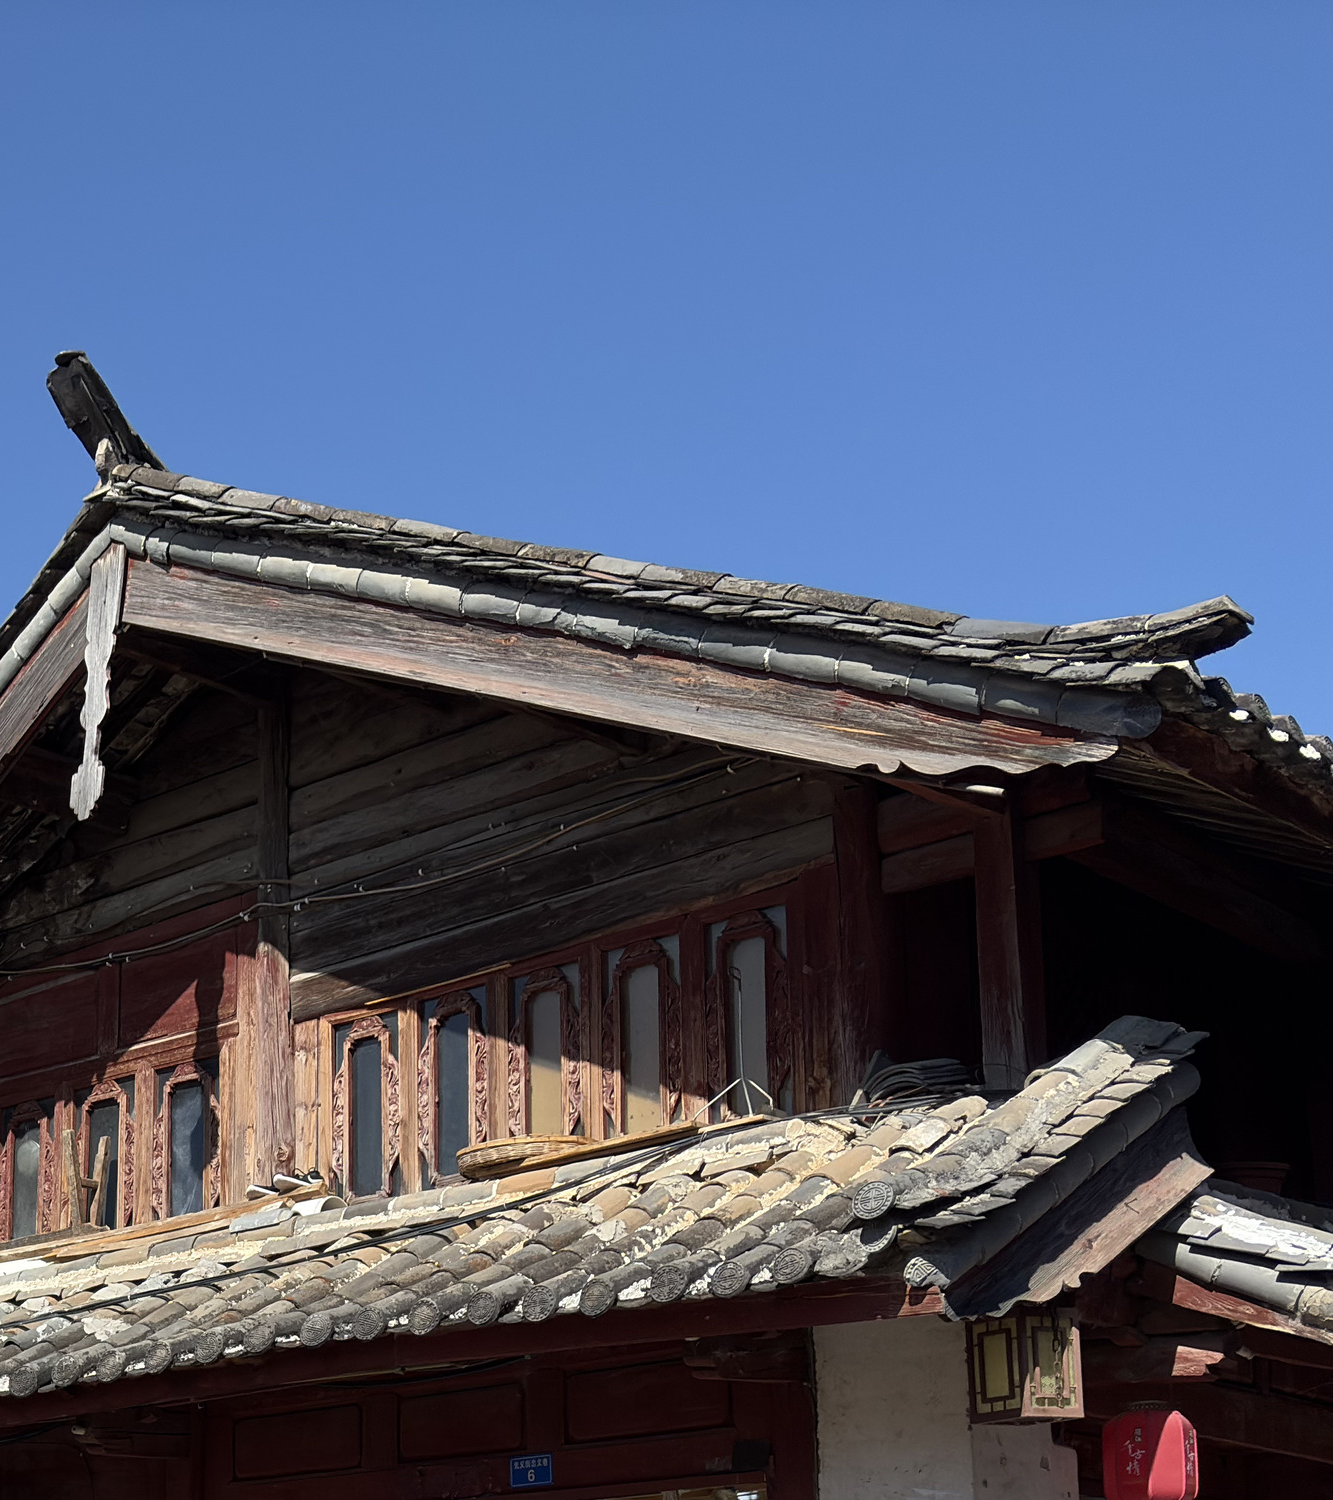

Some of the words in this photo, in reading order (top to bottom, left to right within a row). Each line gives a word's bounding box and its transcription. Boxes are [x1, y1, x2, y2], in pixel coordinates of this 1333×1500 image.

[1124, 1440, 1145, 1476] 千古情
[527, 1469, 535, 1481] 6
